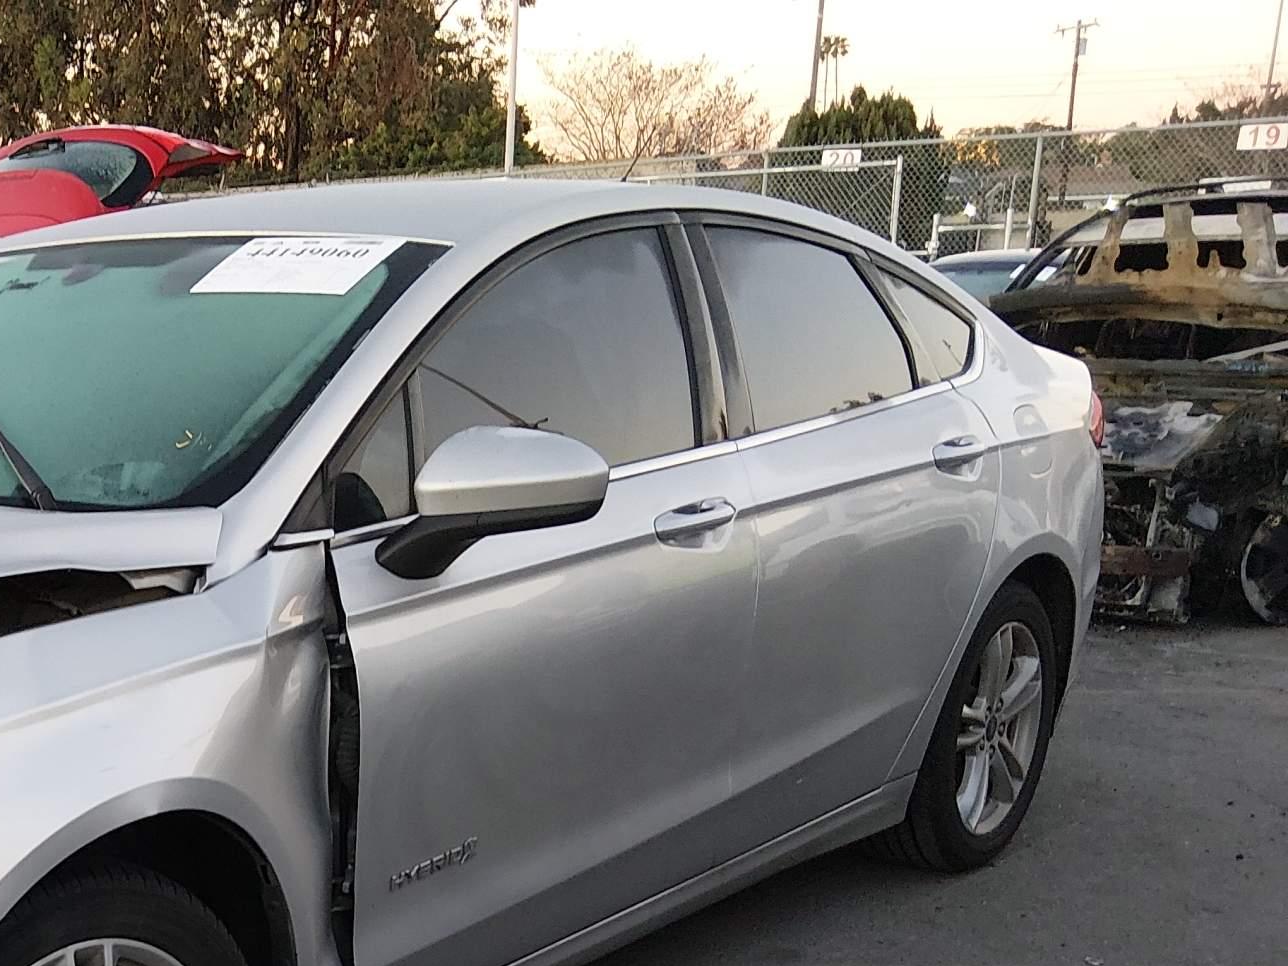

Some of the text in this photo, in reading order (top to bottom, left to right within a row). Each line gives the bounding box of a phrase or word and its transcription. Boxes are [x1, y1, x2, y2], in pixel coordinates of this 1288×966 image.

[1248, 125, 1281, 147] 19
[829, 151, 855, 168] 20
[247, 247, 370, 258] 44149060
[389, 836, 478, 892] HYBRID
